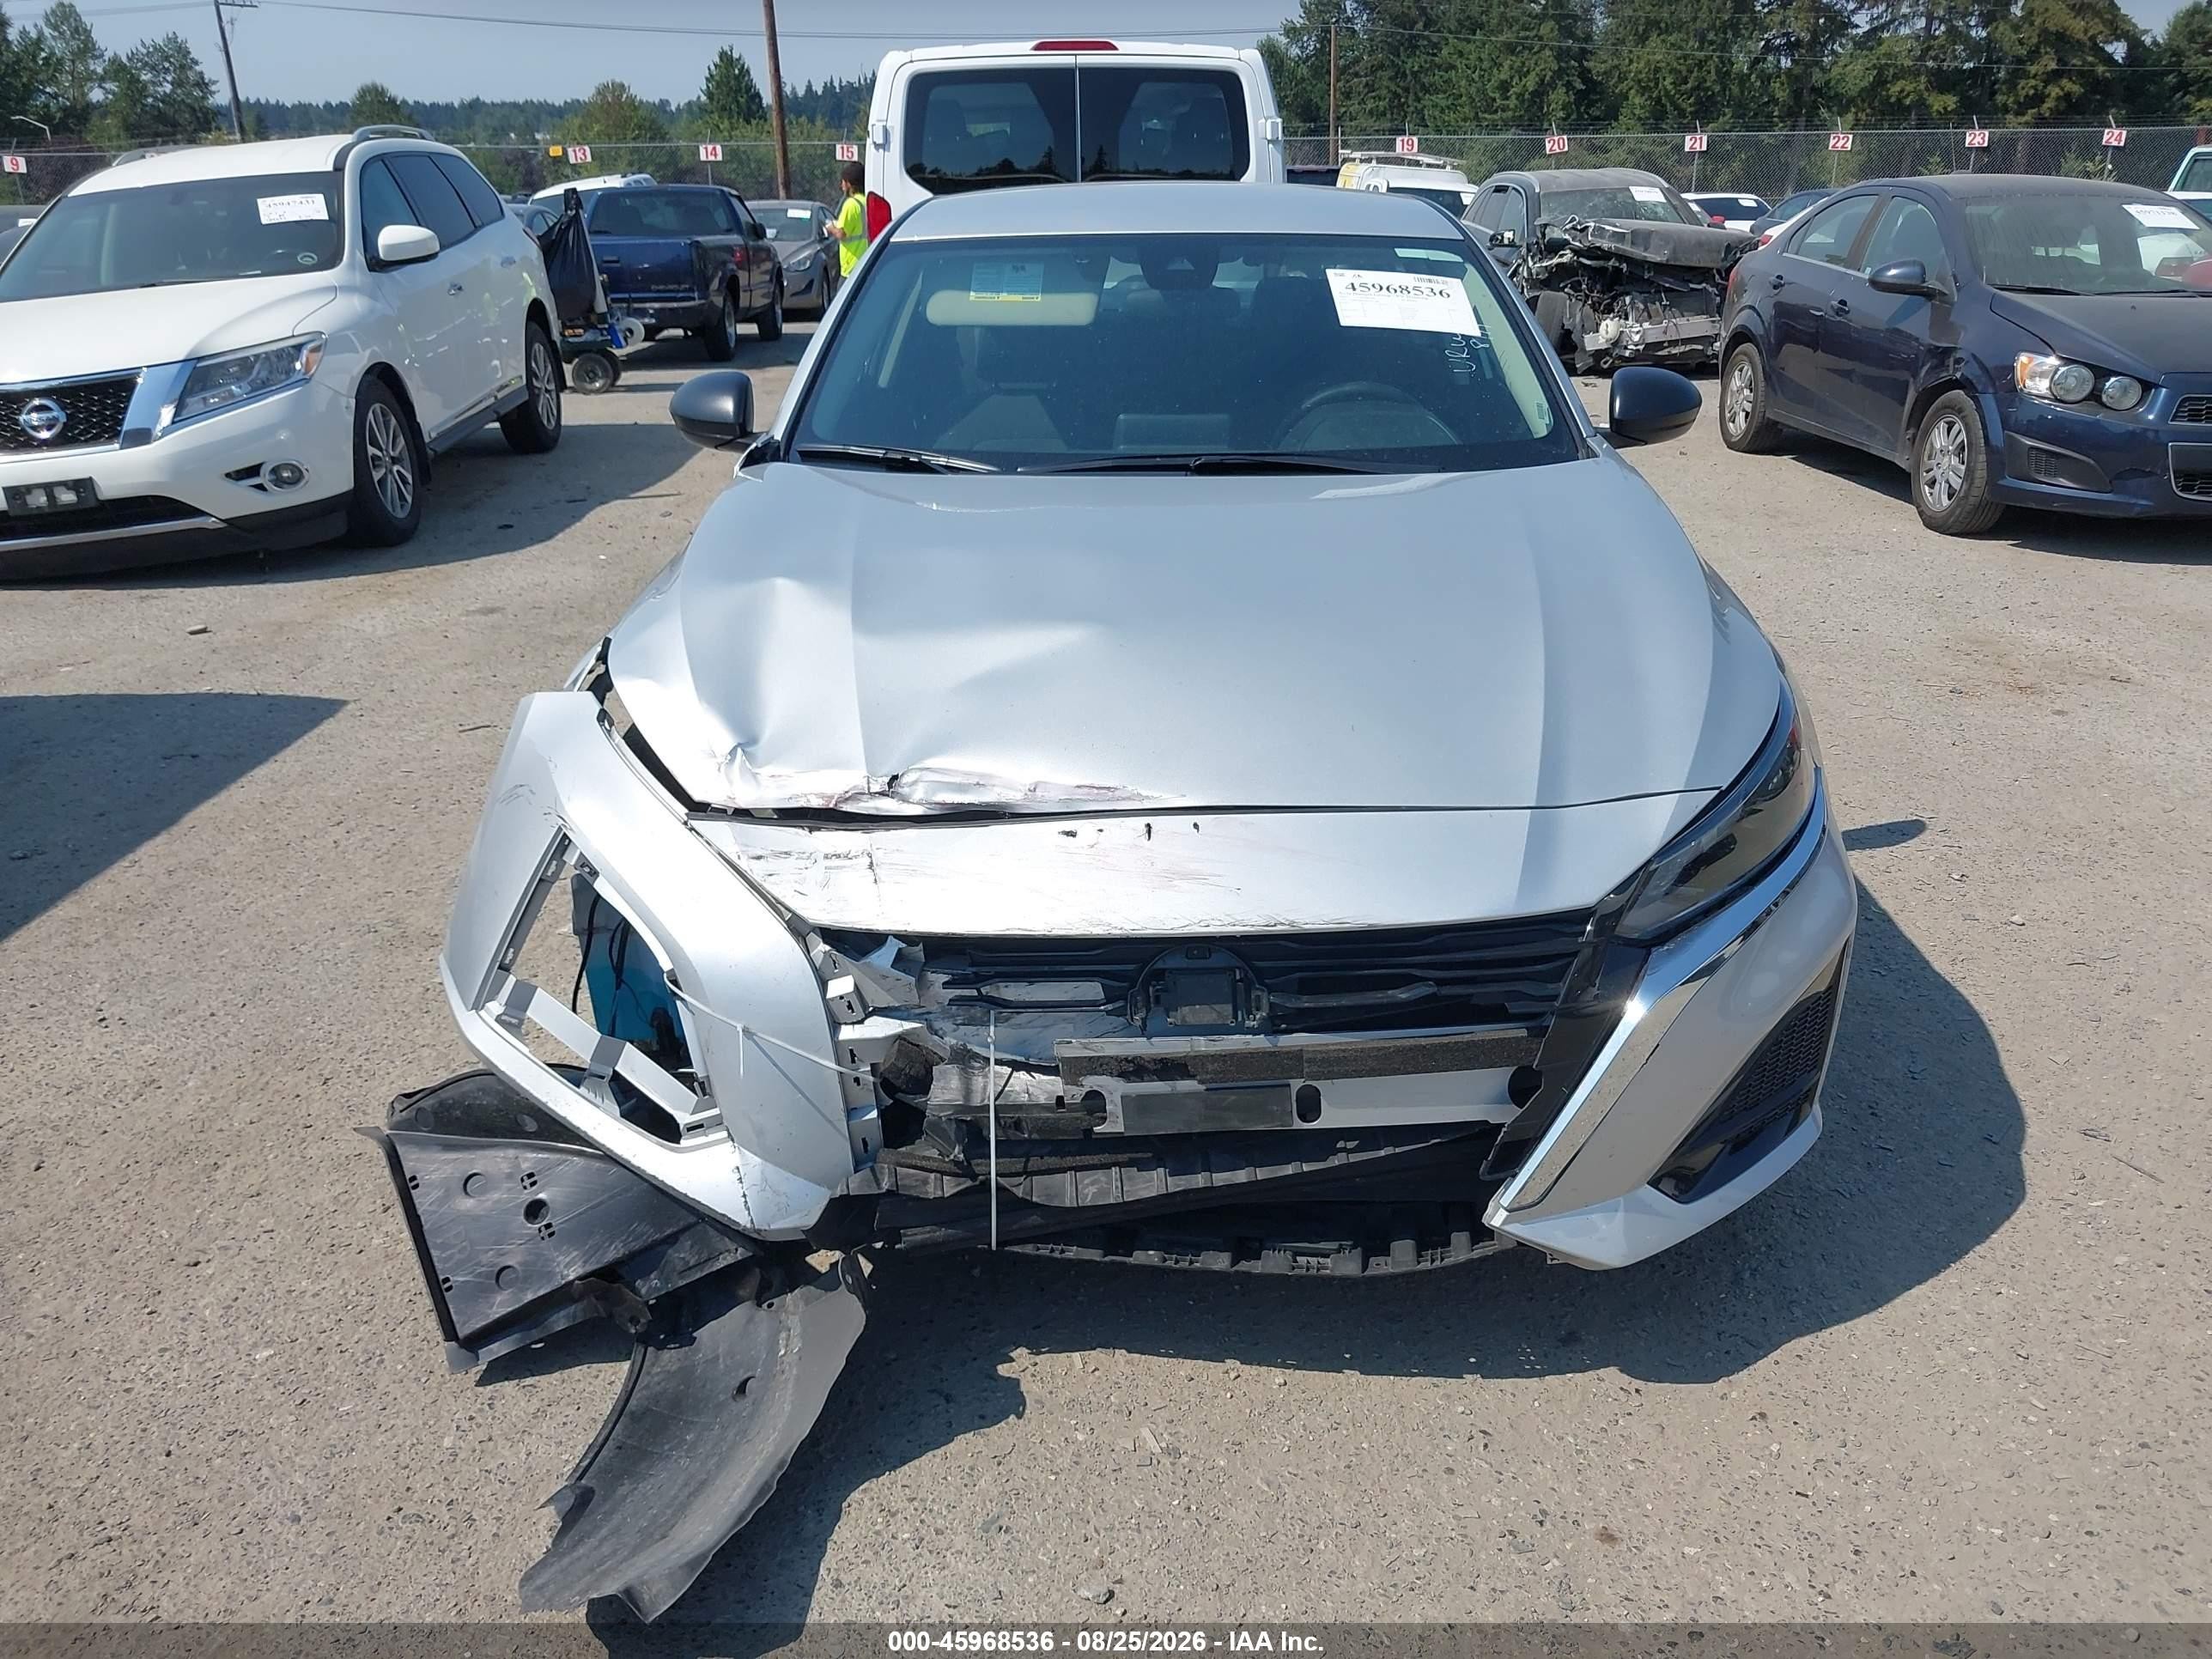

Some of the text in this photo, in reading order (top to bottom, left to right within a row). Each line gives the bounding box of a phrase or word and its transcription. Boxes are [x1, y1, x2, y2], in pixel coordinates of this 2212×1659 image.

[1400, 137, 1414, 152] 19
[1548, 137, 1565, 152] 20
[1689, 136, 1703, 150] 21
[1831, 135, 1850, 149] 22
[1967, 131, 1986, 146] 23
[2105, 130, 2123, 144] 24
[572, 147, 587, 161] 13
[703, 145, 718, 160] 14
[840, 146, 854, 160] 15
[10, 157, 19, 172] 9
[1345, 282, 1451, 299] 45968536
